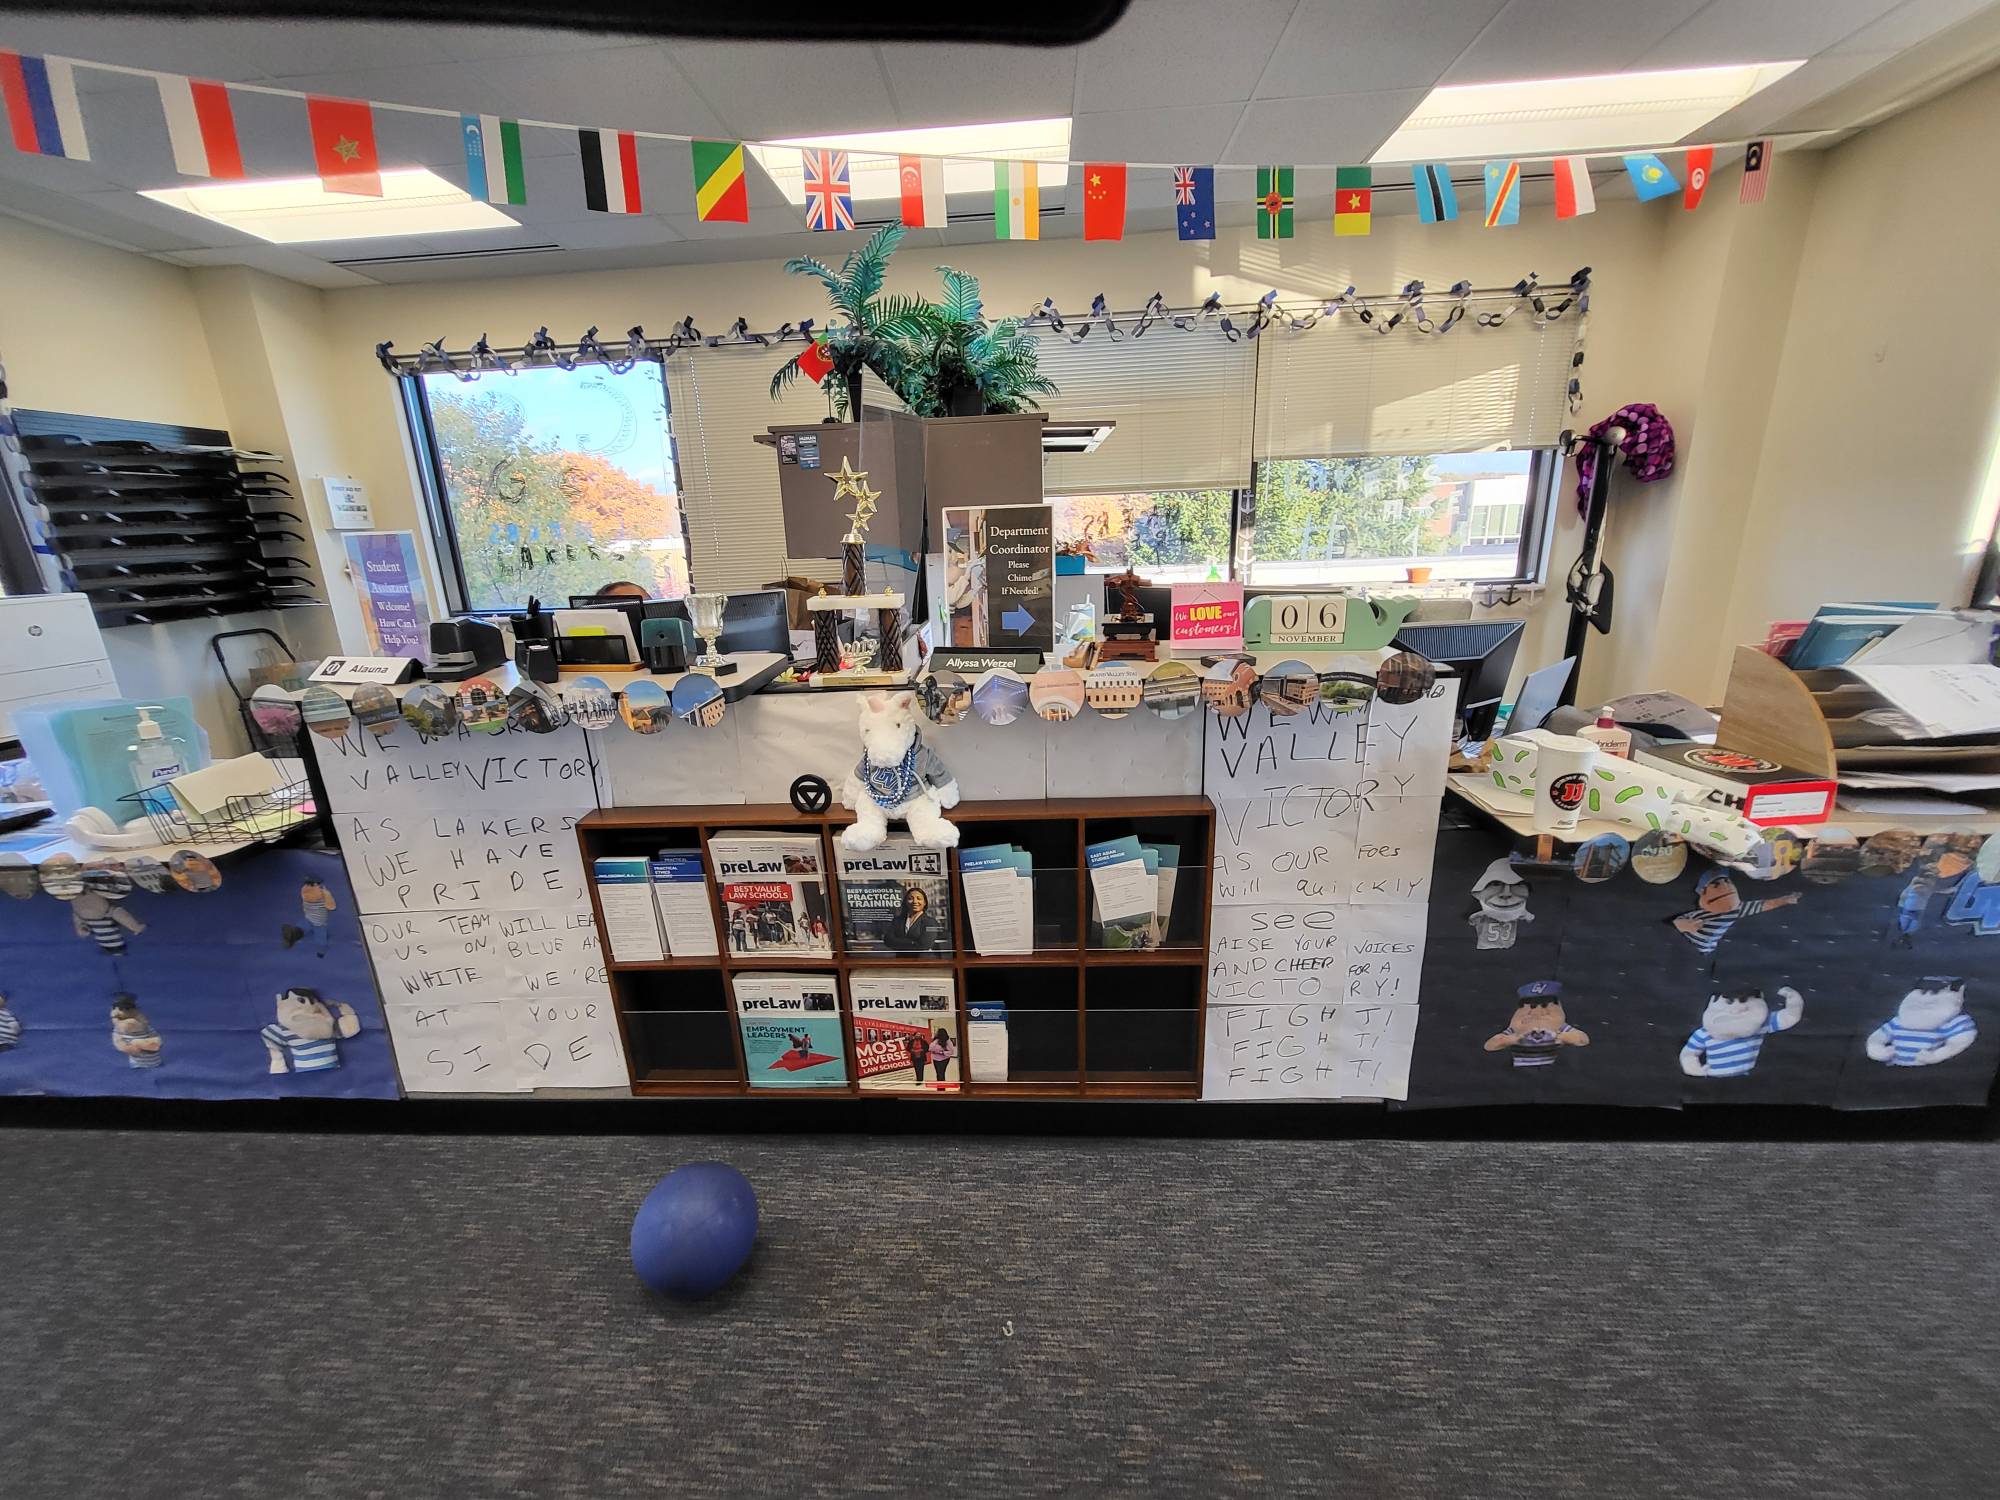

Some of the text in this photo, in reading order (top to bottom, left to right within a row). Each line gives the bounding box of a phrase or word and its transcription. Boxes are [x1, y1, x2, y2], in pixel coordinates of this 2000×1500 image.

[990, 526, 1049, 539] Department
[989, 544, 1050, 555] Coordinator
[366, 560, 400, 572] Student
[1008, 561, 1030, 569] Please
[1007, 573, 1033, 582] Chime
[371, 582, 408, 593] Assistant
[1001, 587, 1039, 595] If Needed!
[377, 602, 410, 611] Welcome!
[1175, 611, 1187, 621] We
[1189, 606, 1222, 621] LOVE
[379, 618, 395, 627] How
[397, 618, 411, 628] Can
[1175, 618, 1238, 637] customers!
[384, 634, 419, 646] Help You?
[1278, 634, 1337, 643] NOVEMBER
[349, 664, 389, 674] Alauna
[946, 658, 1016, 669] Allyssa Wetzel
[1220, 715, 1418, 778] VALLEY
[351, 761, 461, 790] VALLEY
[1561, 783, 1585, 802] JJ
[1218, 774, 1415, 846] VICTORY
[354, 816, 578, 843] AS LAKERS
[363, 843, 553, 887] WE HAVE
[843, 858, 907, 874] preLaw
[1271, 846, 1329, 872] OUR
[720, 860, 782, 877] preLaw
[848, 900, 901, 908] TRAINING
[372, 911, 596, 943] OUR TEAM WILL LEA
[1488, 922, 1512, 941] 53
[394, 944, 428, 961] US
[507, 938, 563, 958] BLUE
[582, 936, 602, 950] AN
[1212, 934, 1415, 956] AISE YOUR VOICES
[1212, 957, 1391, 978] AND CHEER FOR A
[400, 967, 483, 994] WHITE
[742, 997, 801, 1012] preLaw
[858, 997, 918, 1012] preLaw
[416, 1003, 598, 1027] AT YOUR
[1226, 1004, 1393, 1037] FIGHT!
[856, 1037, 906, 1059] MOST
[1232, 1032, 1379, 1061] FIGHT!
[859, 1051, 909, 1068] DIVERSE
[863, 1061, 911, 1075] LAW SCHOOLS
[1229, 1059, 1382, 1087] FIGHT!
